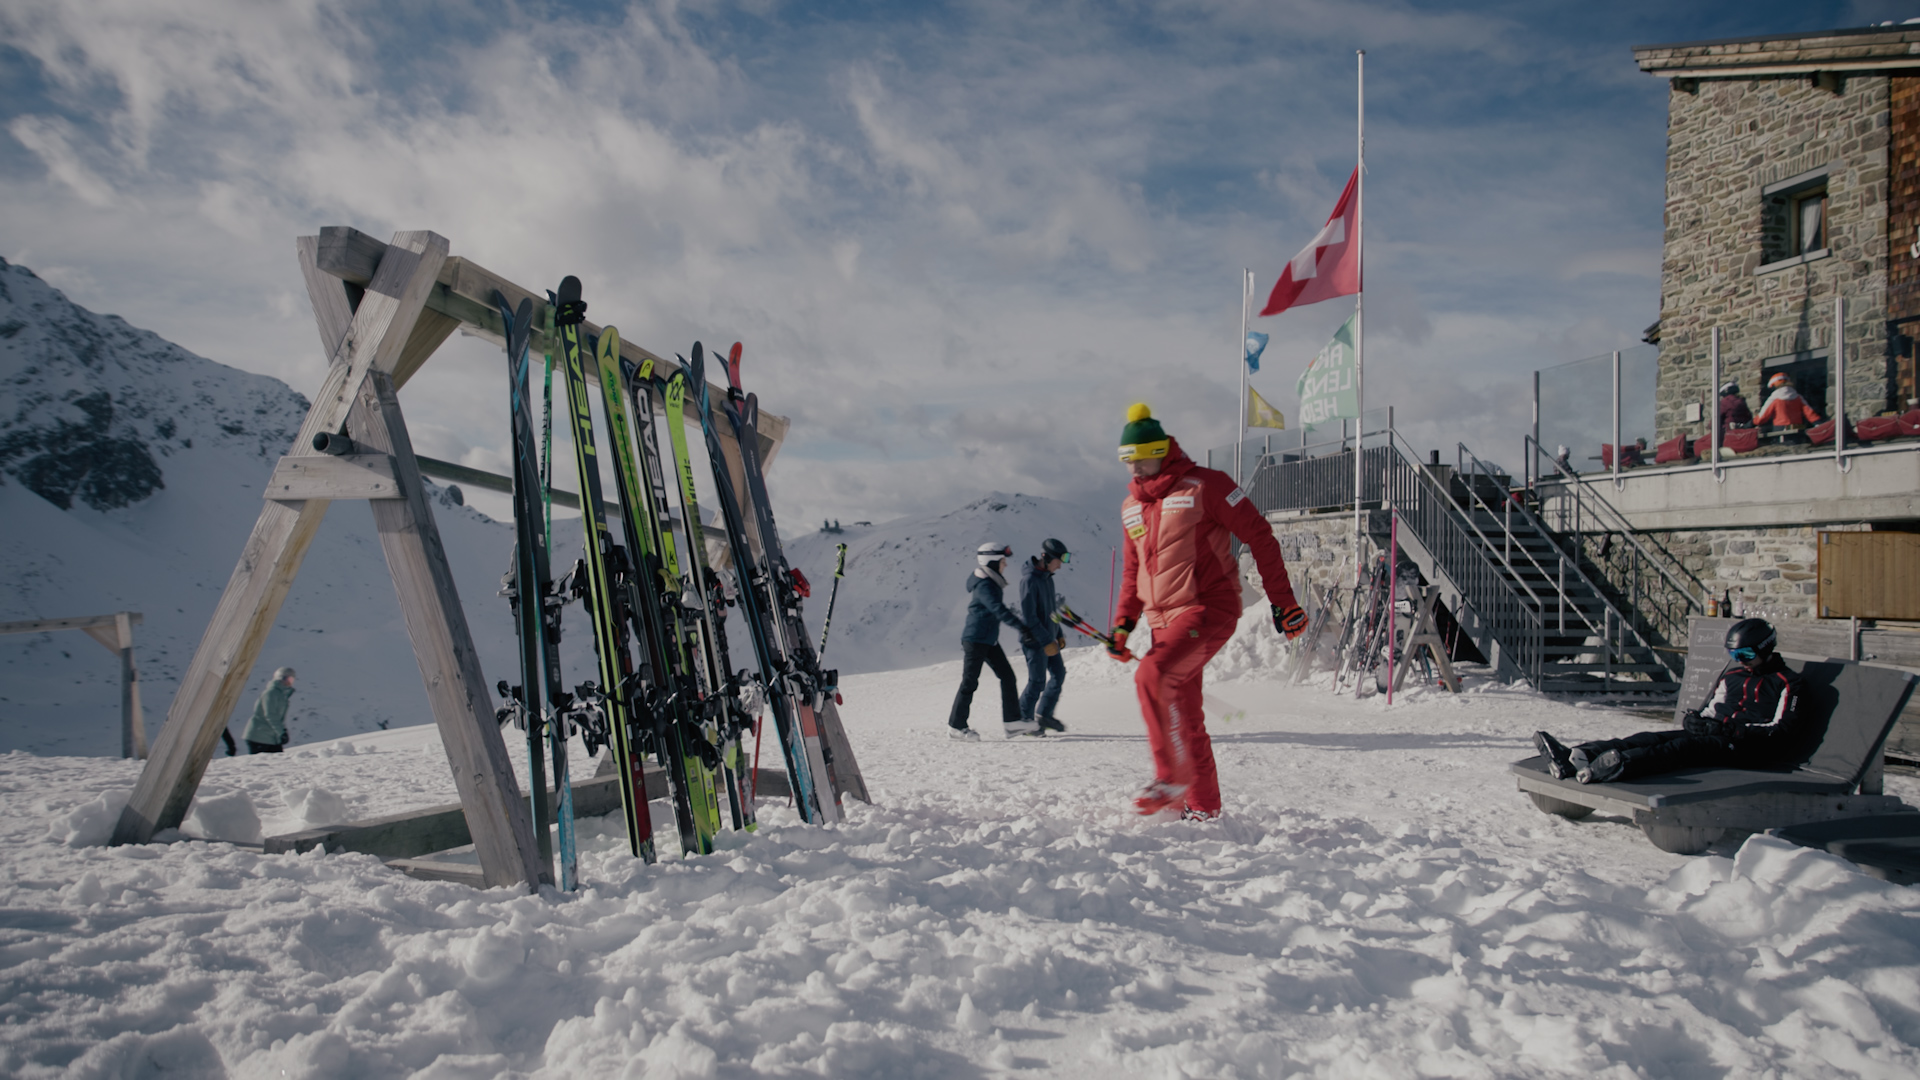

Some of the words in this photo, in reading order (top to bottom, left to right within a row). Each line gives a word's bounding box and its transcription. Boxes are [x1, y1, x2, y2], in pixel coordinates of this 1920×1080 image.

[563, 305, 596, 456] HEAD
[636, 388, 669, 521] HEAD
[793, 725, 812, 796] VEMENT
[563, 780, 575, 867] VEMENT
